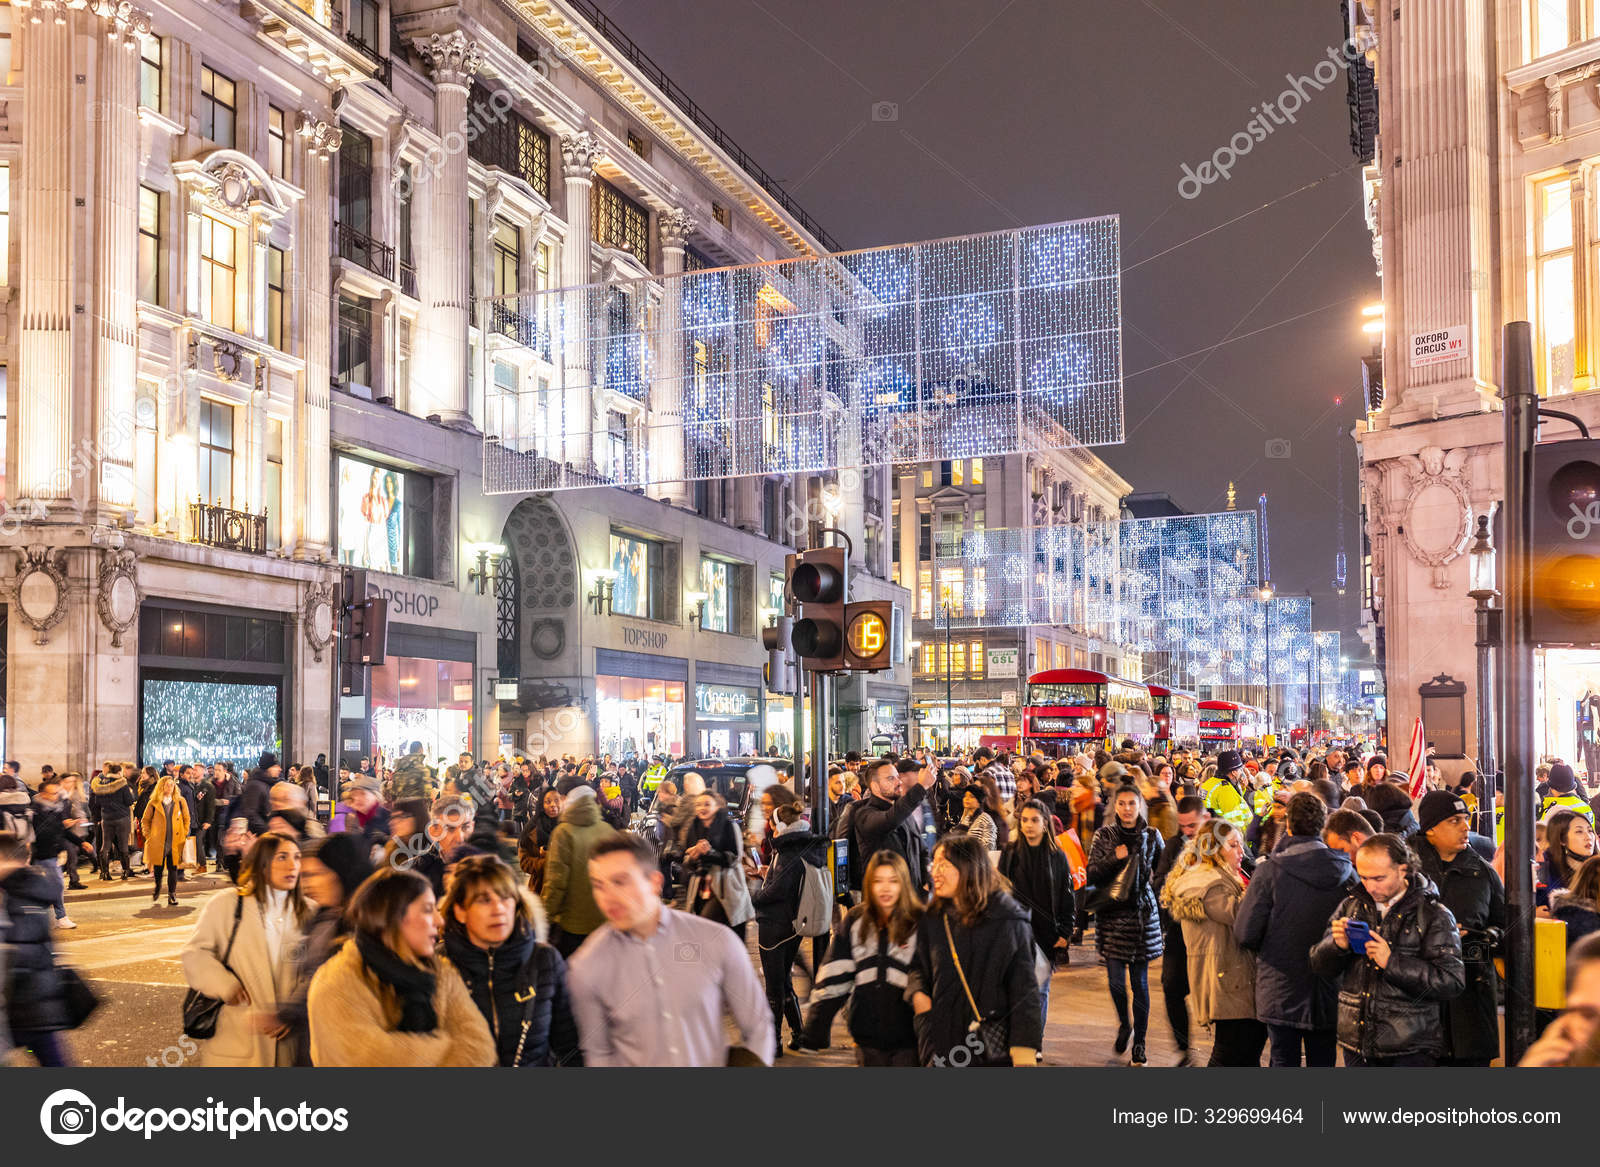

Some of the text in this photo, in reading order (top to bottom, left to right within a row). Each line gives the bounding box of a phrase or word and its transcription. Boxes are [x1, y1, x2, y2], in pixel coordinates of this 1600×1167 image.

[1415, 332, 1449, 345] OXFORD
[1415, 339, 1462, 355] CIRCUS W1
[622, 626, 668, 649] TOPSHOP
[863, 619, 880, 649] 15
[992, 656, 1014, 664] GSL
[696, 683, 746, 714] TOPSHOP
[1077, 718, 1090, 730] 390
[1221, 728, 1230, 736] 73
[154, 745, 265, 759] WATER REPELLENT
